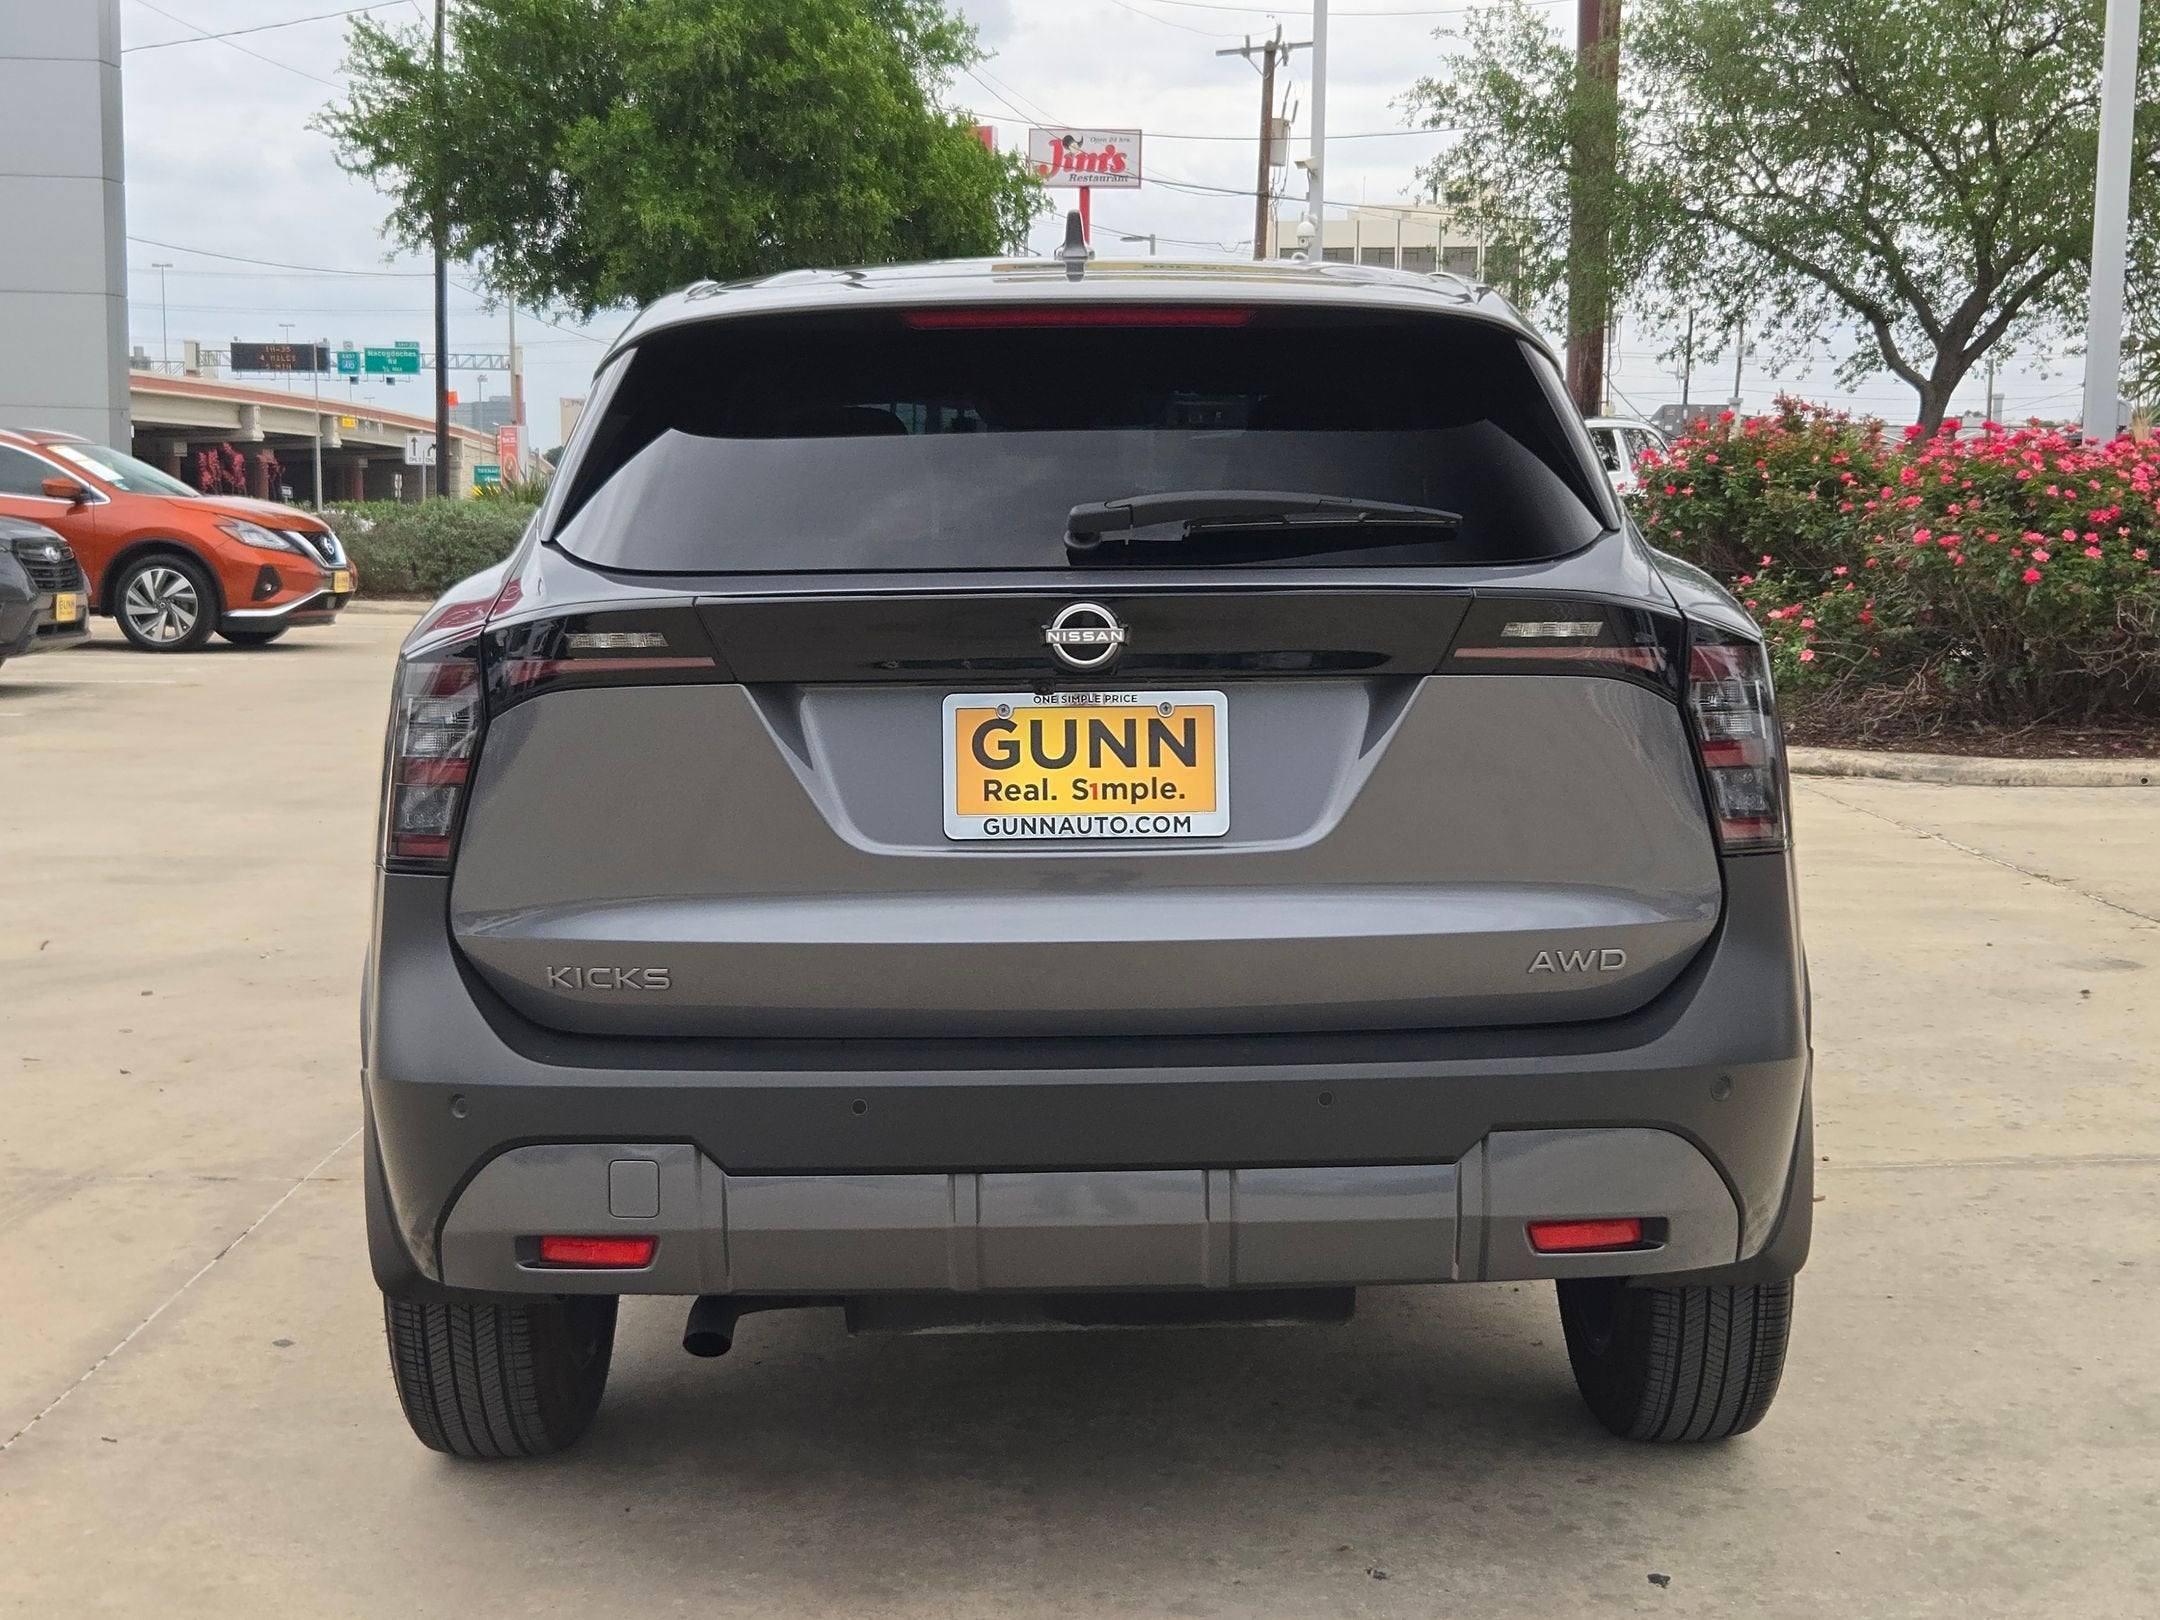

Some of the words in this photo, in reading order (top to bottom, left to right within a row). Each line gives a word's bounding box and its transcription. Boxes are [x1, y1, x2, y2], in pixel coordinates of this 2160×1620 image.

[1037, 138, 1128, 181] Jim's
[1069, 173, 1129, 183] Restaurant
[367, 350, 417, 358] Nacogdoches
[1047, 630, 1124, 642] NISSAN
[1033, 695, 1058, 704] ONE
[1061, 694, 1102, 704] SIMPLE
[1105, 694, 1138, 703] PRICE
[972, 716, 1197, 770] GUNN
[983, 777, 1058, 801] Real.
[1072, 776, 1186, 805] S1mple.
[983, 815, 1192, 836] GUNNAUTO.COM
[1527, 949, 1628, 974] AWD
[546, 965, 672, 990] KICKS
